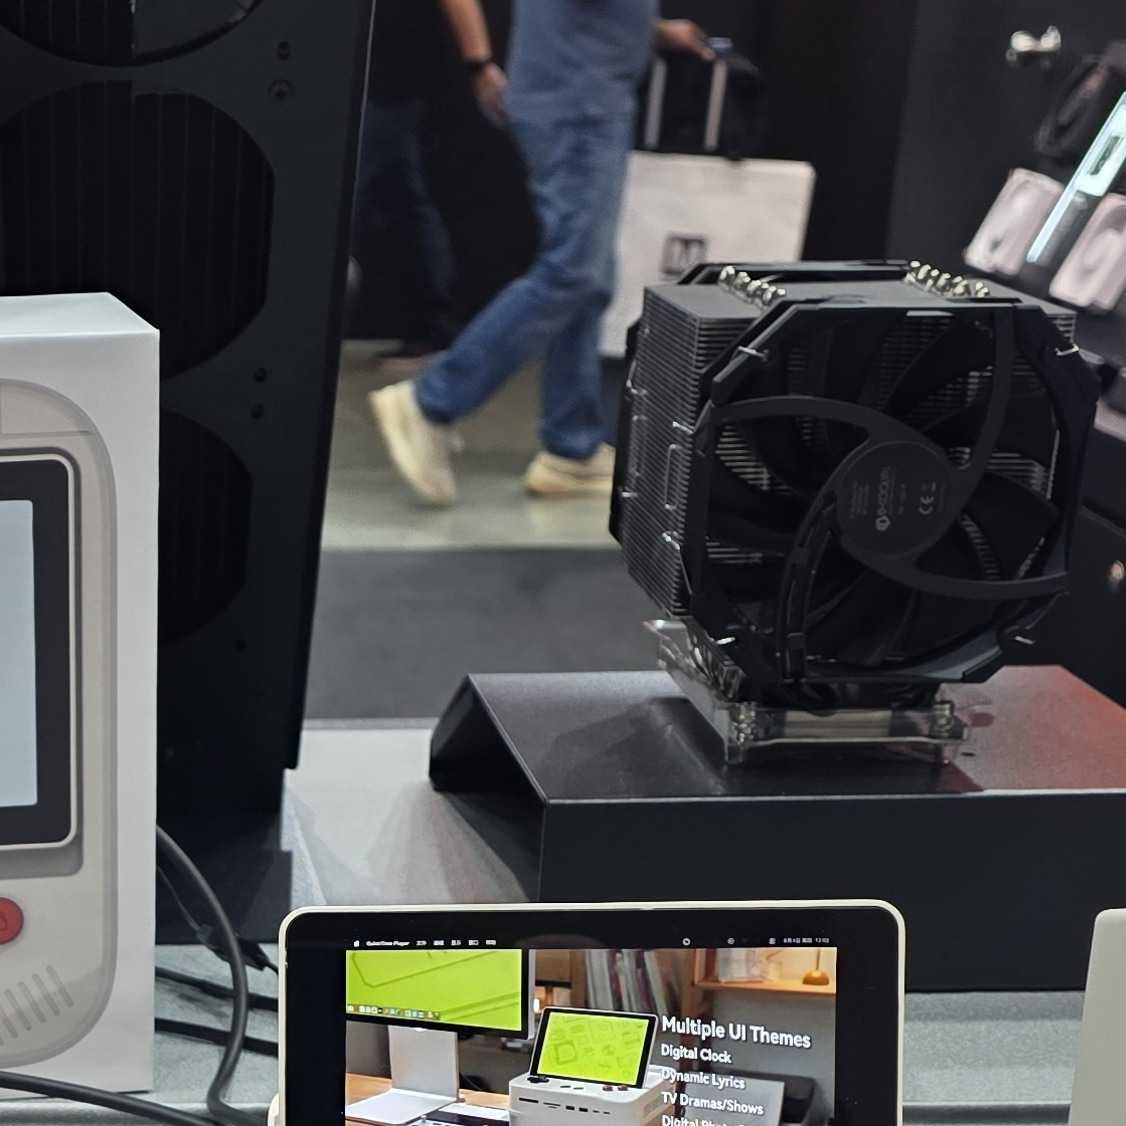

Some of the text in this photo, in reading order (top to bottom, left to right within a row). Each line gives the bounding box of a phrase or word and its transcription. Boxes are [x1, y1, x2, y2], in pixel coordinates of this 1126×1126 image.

[662, 1016, 811, 1048] Multiple UI Themes
[661, 1044, 732, 1063] Digital Clock
[661, 1069, 745, 1089] Dynamic Lyrics
[662, 1092, 764, 1115] TV Dramas/Shows
